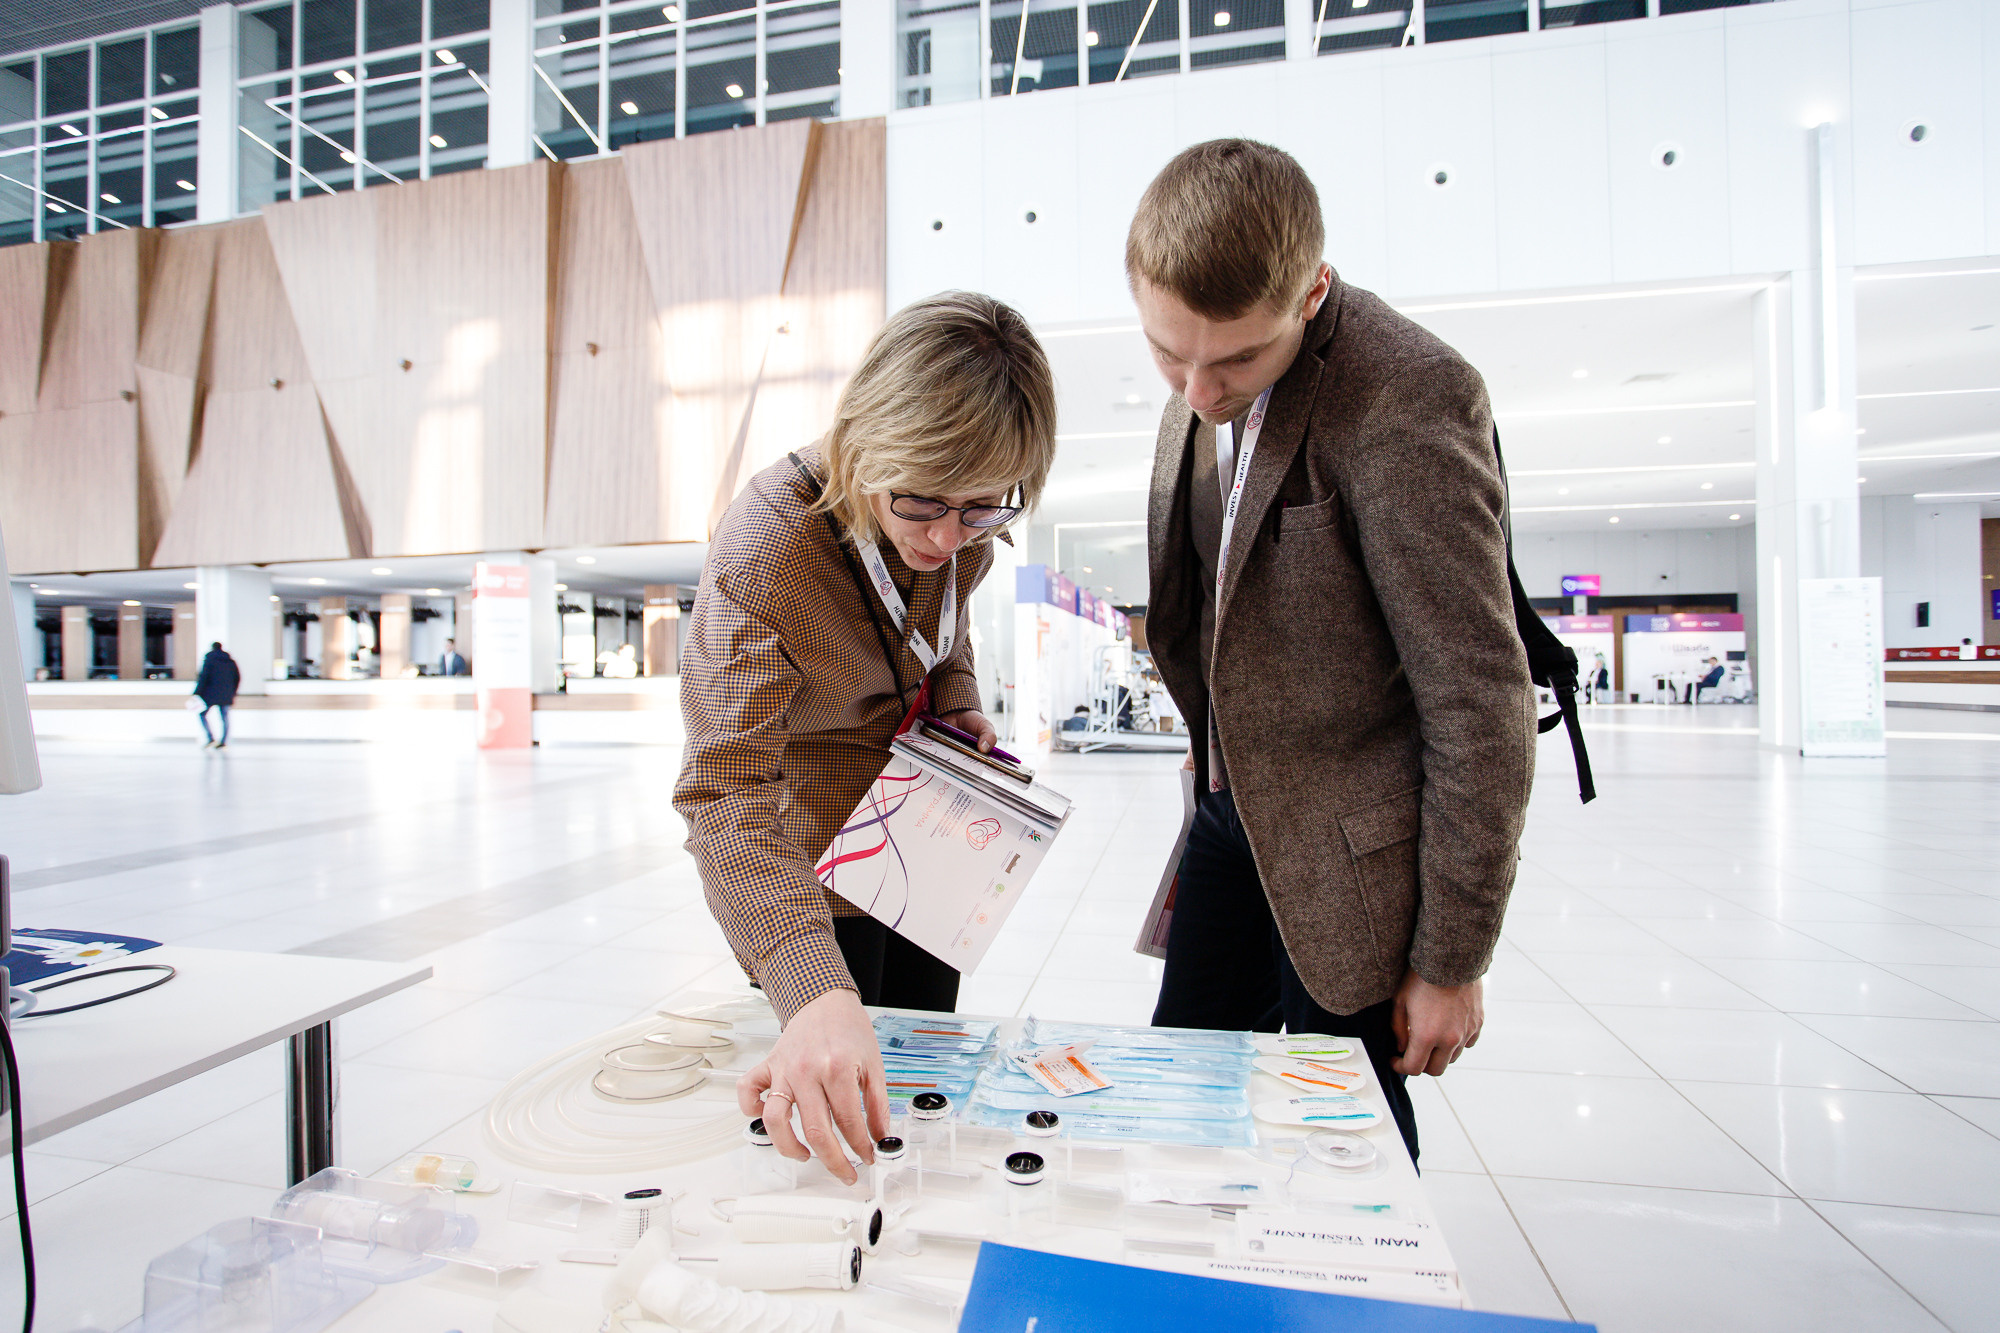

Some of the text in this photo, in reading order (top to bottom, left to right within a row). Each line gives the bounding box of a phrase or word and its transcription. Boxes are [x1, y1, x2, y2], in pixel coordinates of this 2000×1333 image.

[1229, 452, 1249, 518] INVEST HEALTH
[942, 636, 950, 655] INVEST
[1374, 1237, 1419, 1248] MANI
[1335, 1273, 1368, 1283] MANI
